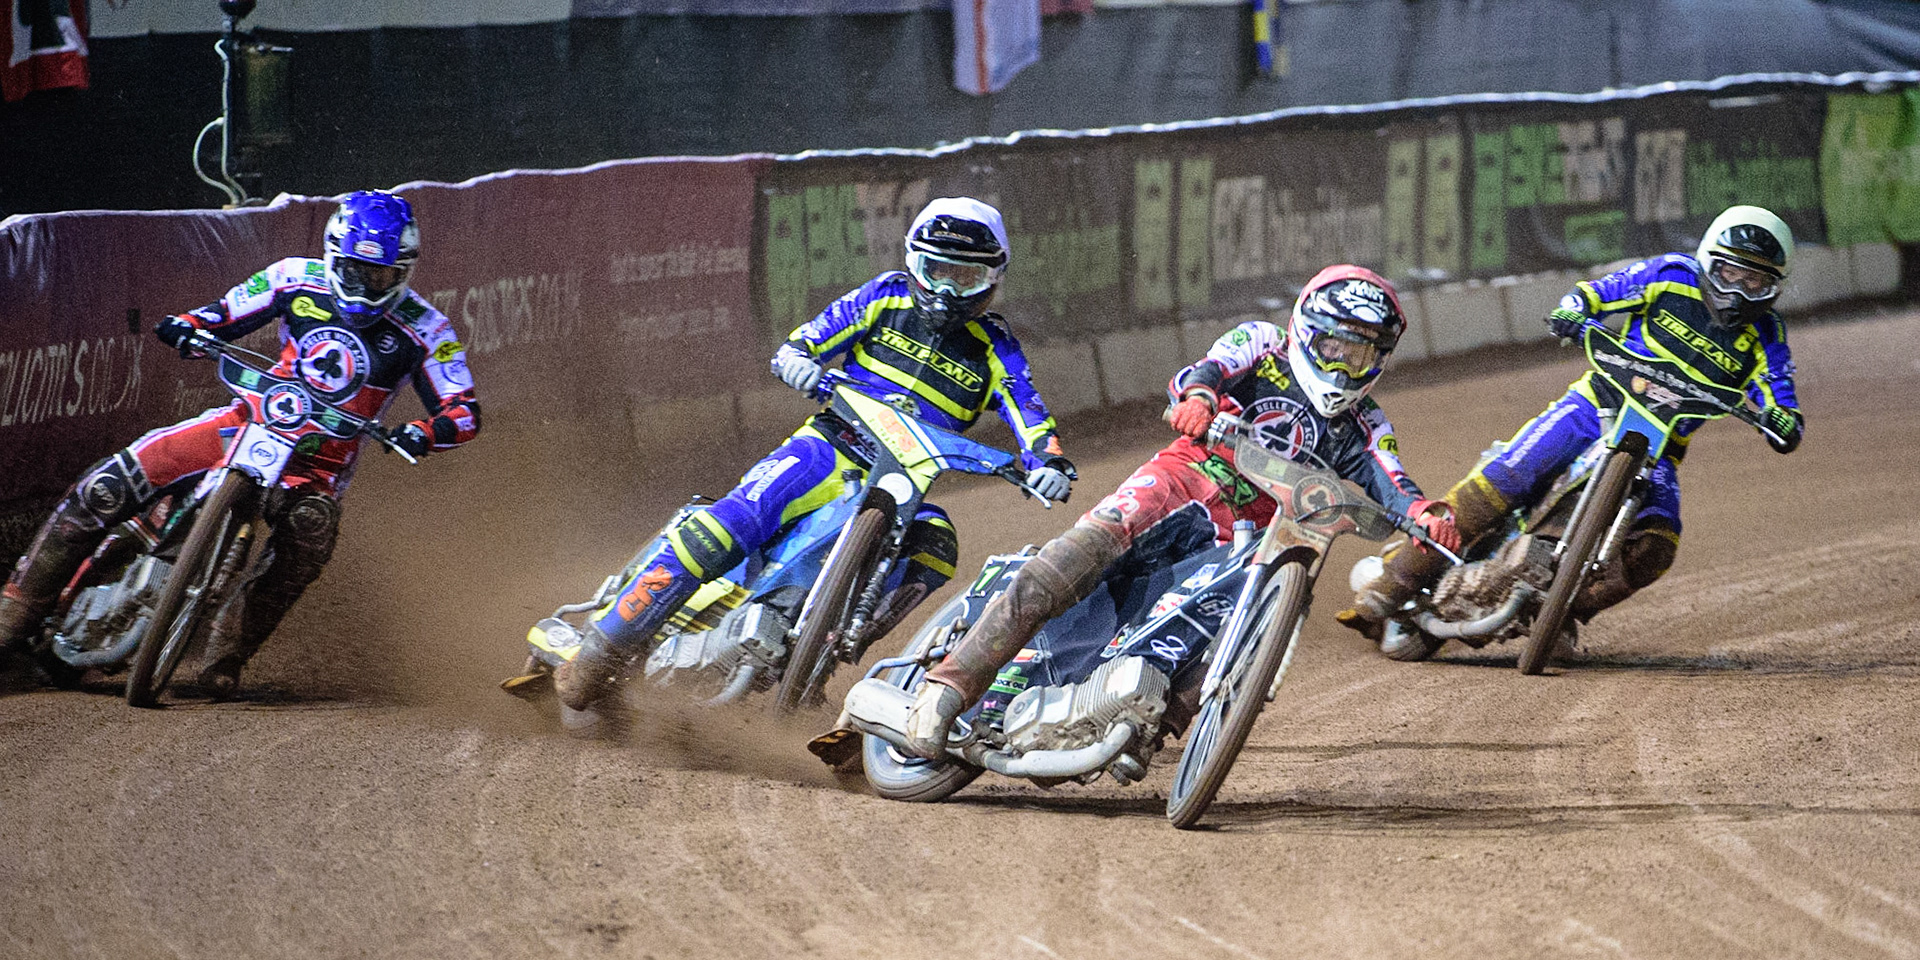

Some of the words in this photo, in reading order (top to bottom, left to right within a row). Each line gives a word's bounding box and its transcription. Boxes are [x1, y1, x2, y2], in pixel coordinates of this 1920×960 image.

[881, 331, 919, 354] TRU
[916, 347, 978, 386] PLANT
[1660, 315, 1696, 341] TRU
[1690, 337, 1743, 373] PLANT
[1733, 333, 1751, 353] 6
[1255, 401, 1289, 413] BELLE
[617, 564, 674, 622] CFS
[974, 565, 1002, 592] 1
